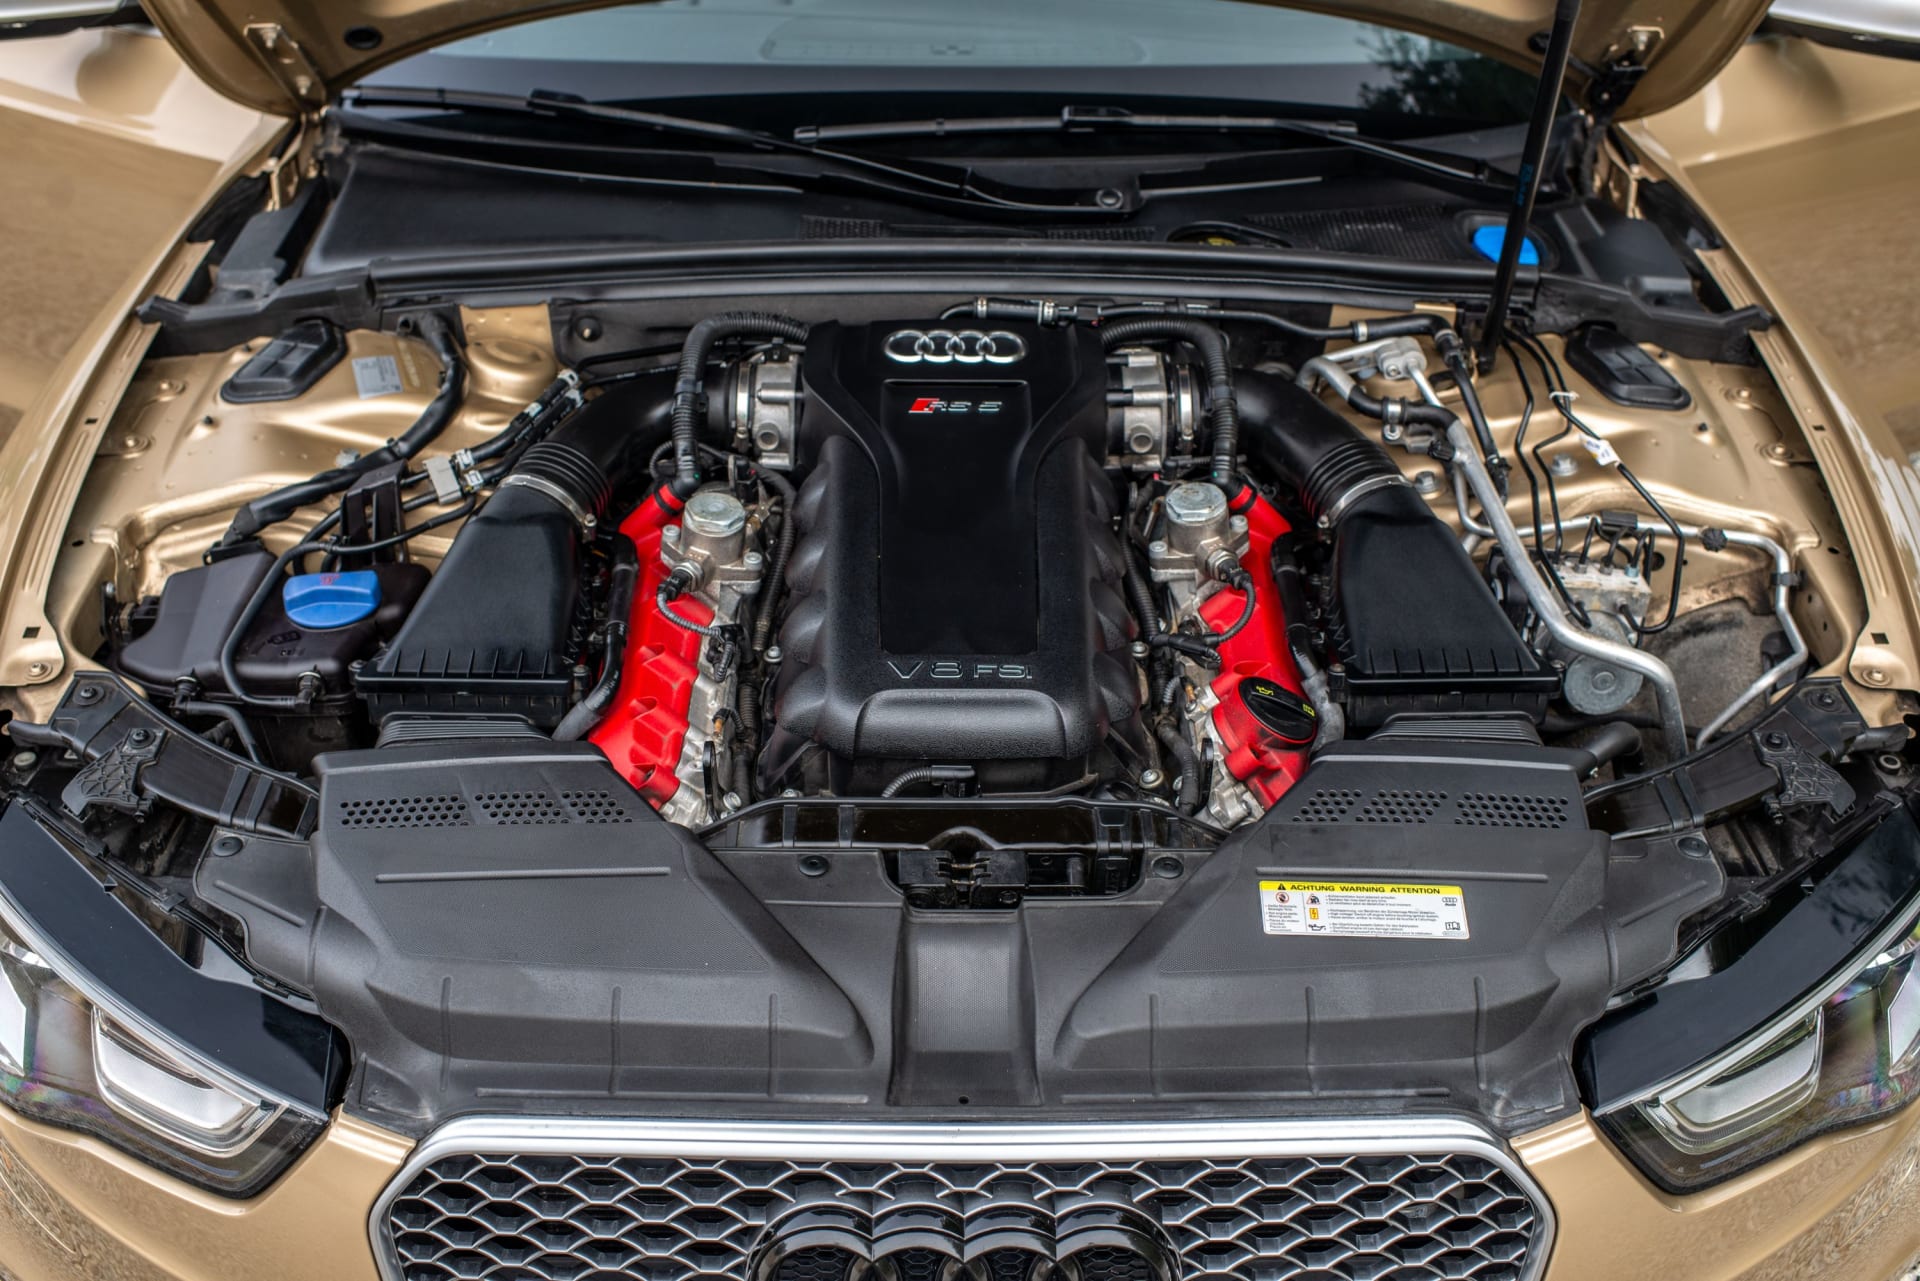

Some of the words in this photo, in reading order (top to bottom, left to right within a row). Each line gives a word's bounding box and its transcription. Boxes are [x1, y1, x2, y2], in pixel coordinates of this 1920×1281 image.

[922, 400, 972, 412] RS
[887, 660, 963, 679] V8
[973, 664, 1033, 679] FSI
[1290, 884, 1335, 892] ACHTUNG
[1339, 885, 1385, 893] WARNING
